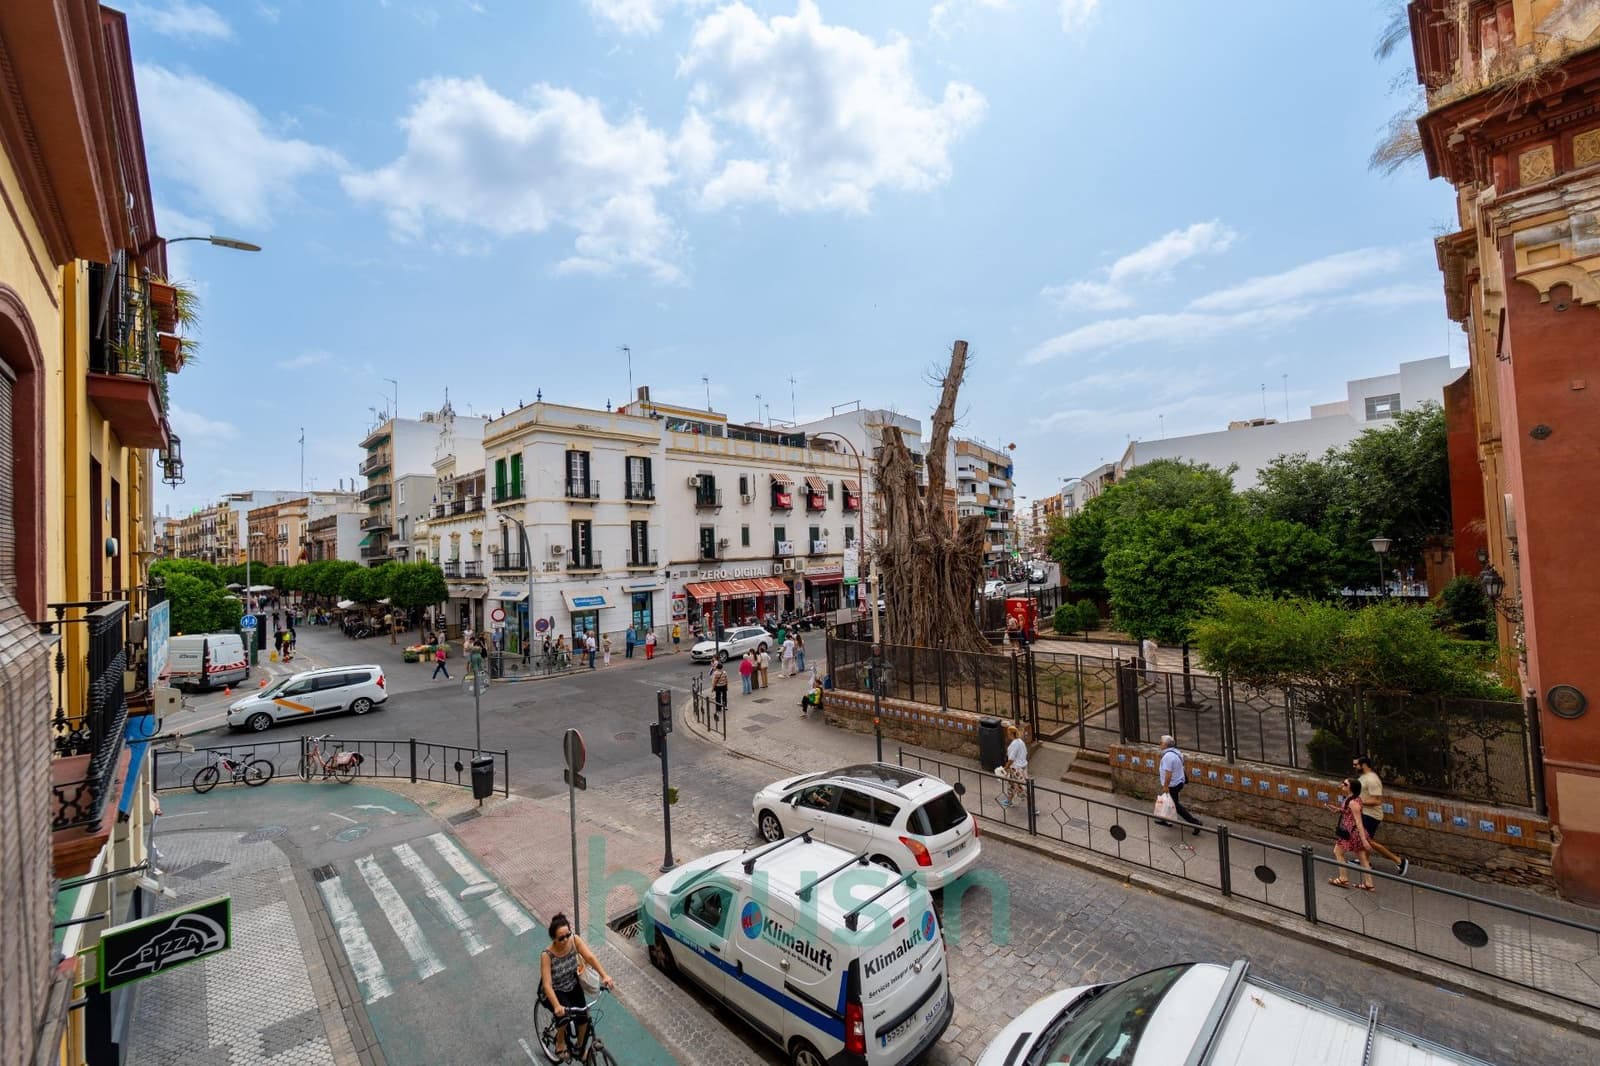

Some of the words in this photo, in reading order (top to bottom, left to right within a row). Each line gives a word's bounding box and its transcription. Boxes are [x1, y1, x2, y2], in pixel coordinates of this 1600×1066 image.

[701, 569, 726, 580] ZERO
[734, 567, 767, 577] DIGITAL
[140, 933, 200, 962] PIZZA
[763, 916, 833, 971] Klimaluft
[864, 928, 922, 978] Klimaluft
[868, 980, 890, 999] Servicio
